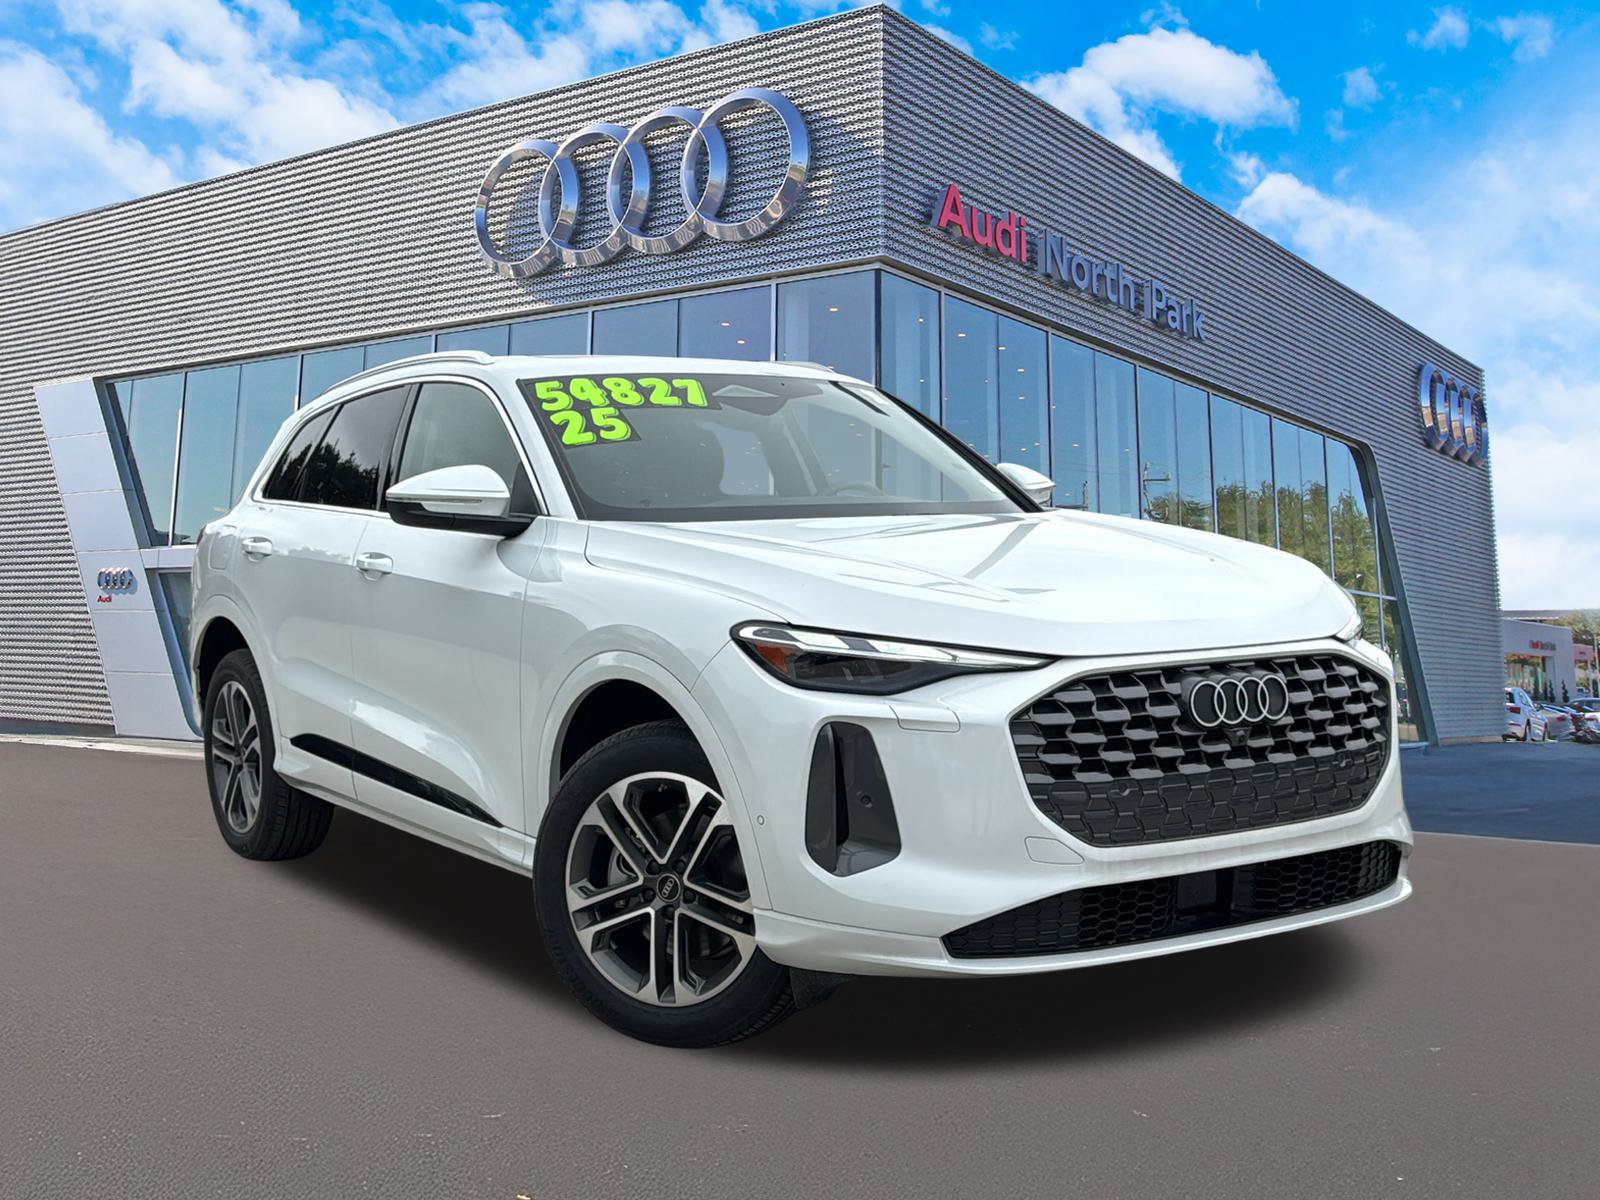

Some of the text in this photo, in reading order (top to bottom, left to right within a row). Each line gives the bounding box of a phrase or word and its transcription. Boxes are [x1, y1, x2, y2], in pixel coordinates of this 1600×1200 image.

[936, 183, 1206, 341] Audi North Park
[534, 377, 708, 411] 54827
[550, 407, 631, 445] 25
